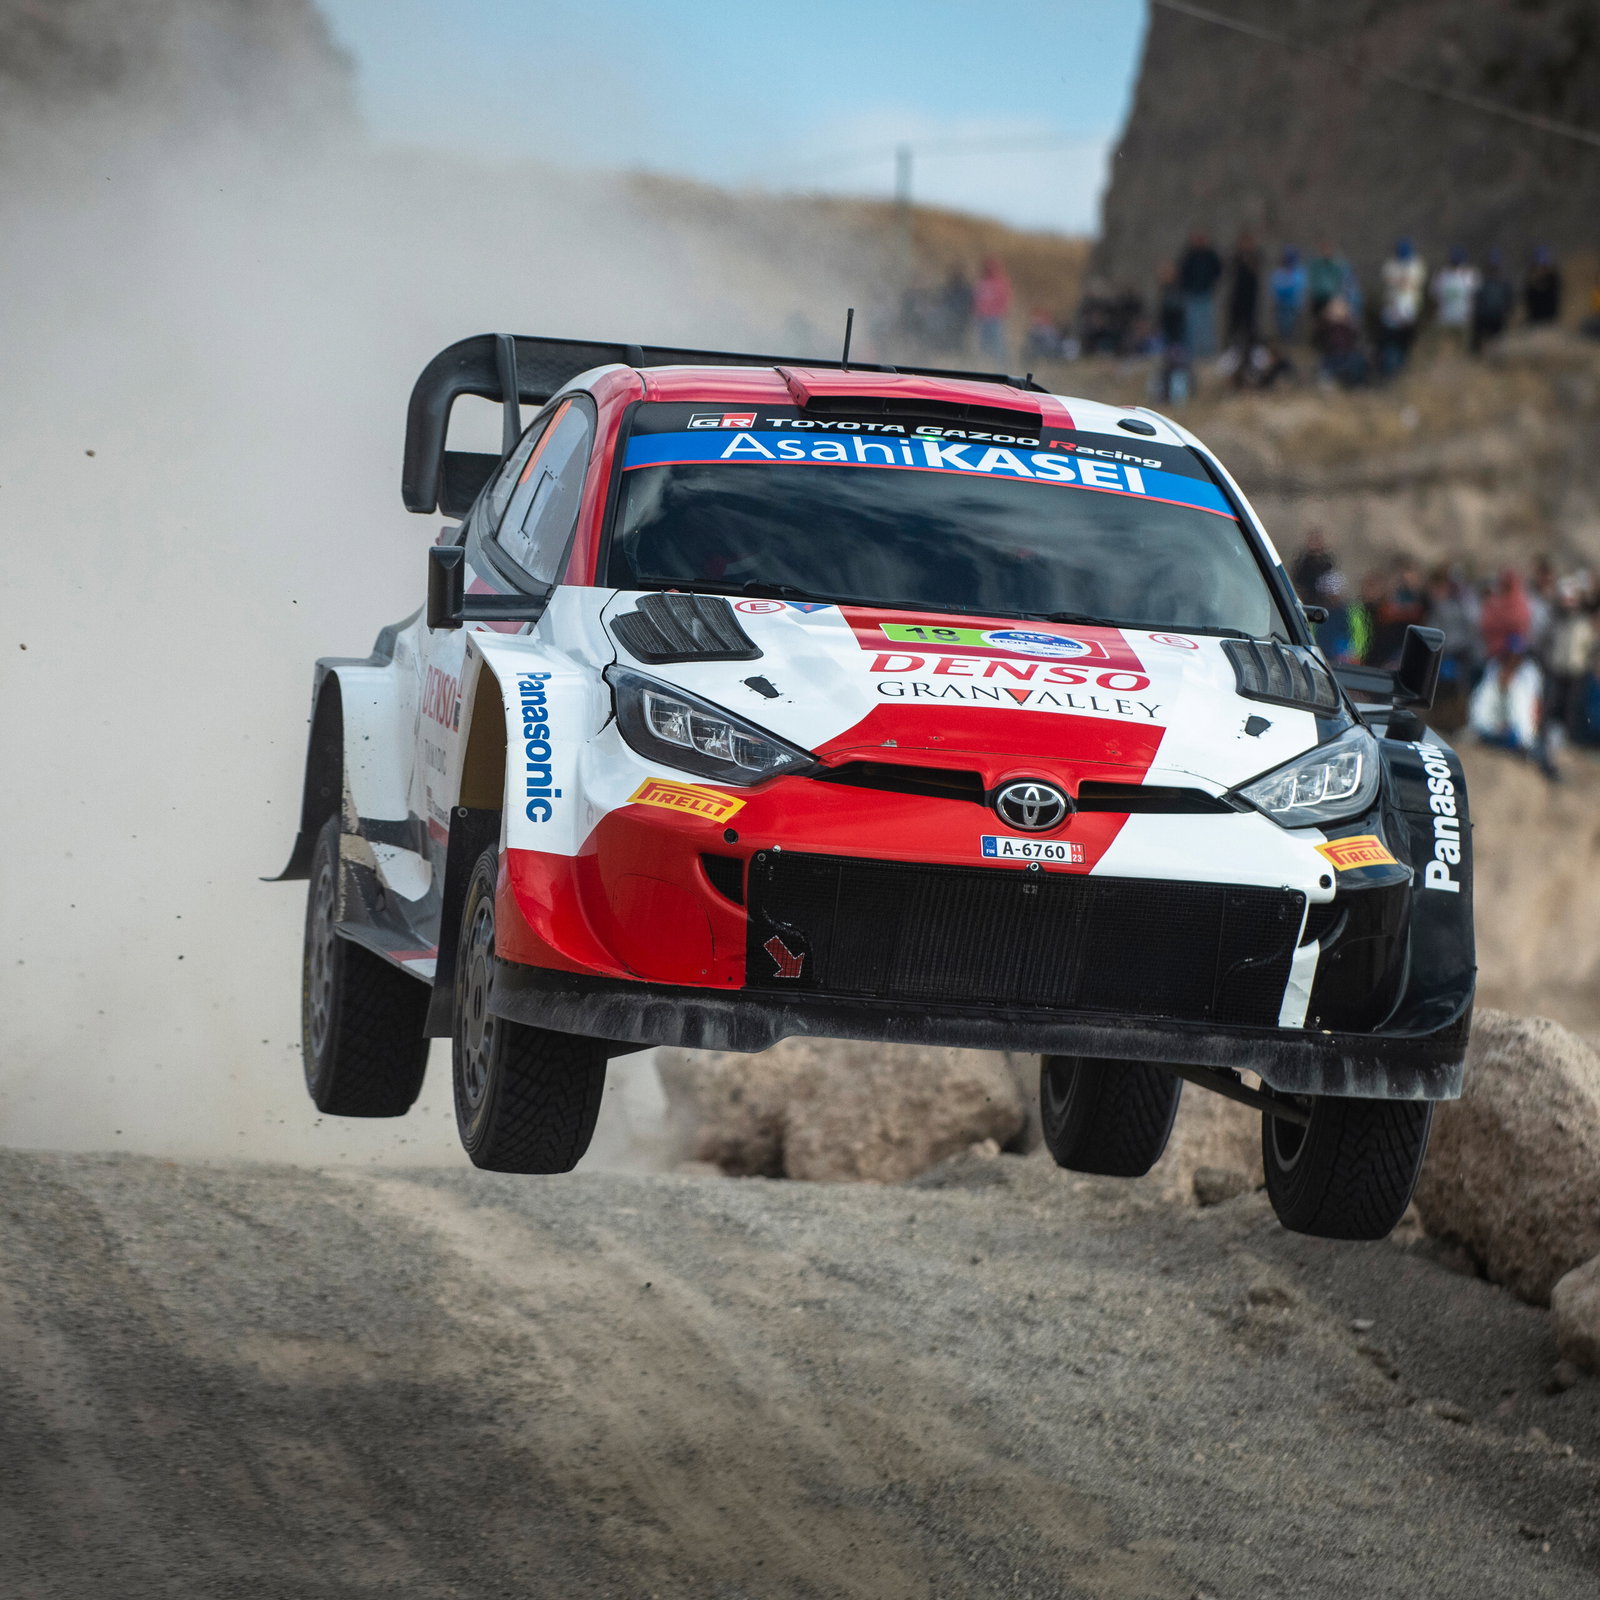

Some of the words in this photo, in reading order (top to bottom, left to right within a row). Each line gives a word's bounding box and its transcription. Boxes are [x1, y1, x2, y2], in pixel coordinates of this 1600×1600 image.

[766, 418, 906, 433] TOYOTA
[915, 425, 1040, 446] GAZOO
[1049, 439, 1162, 469] Racing
[905, 627, 960, 641] 18
[869, 653, 1151, 692] DENSO
[422, 664, 457, 728] DENSO
[516, 672, 562, 823] Panasonic
[637, 782, 734, 817] PIRELLI
[1002, 841, 1065, 859] A-6760
[1072, 854, 1082, 862] 23
[1324, 840, 1391, 865] PIRELLI
